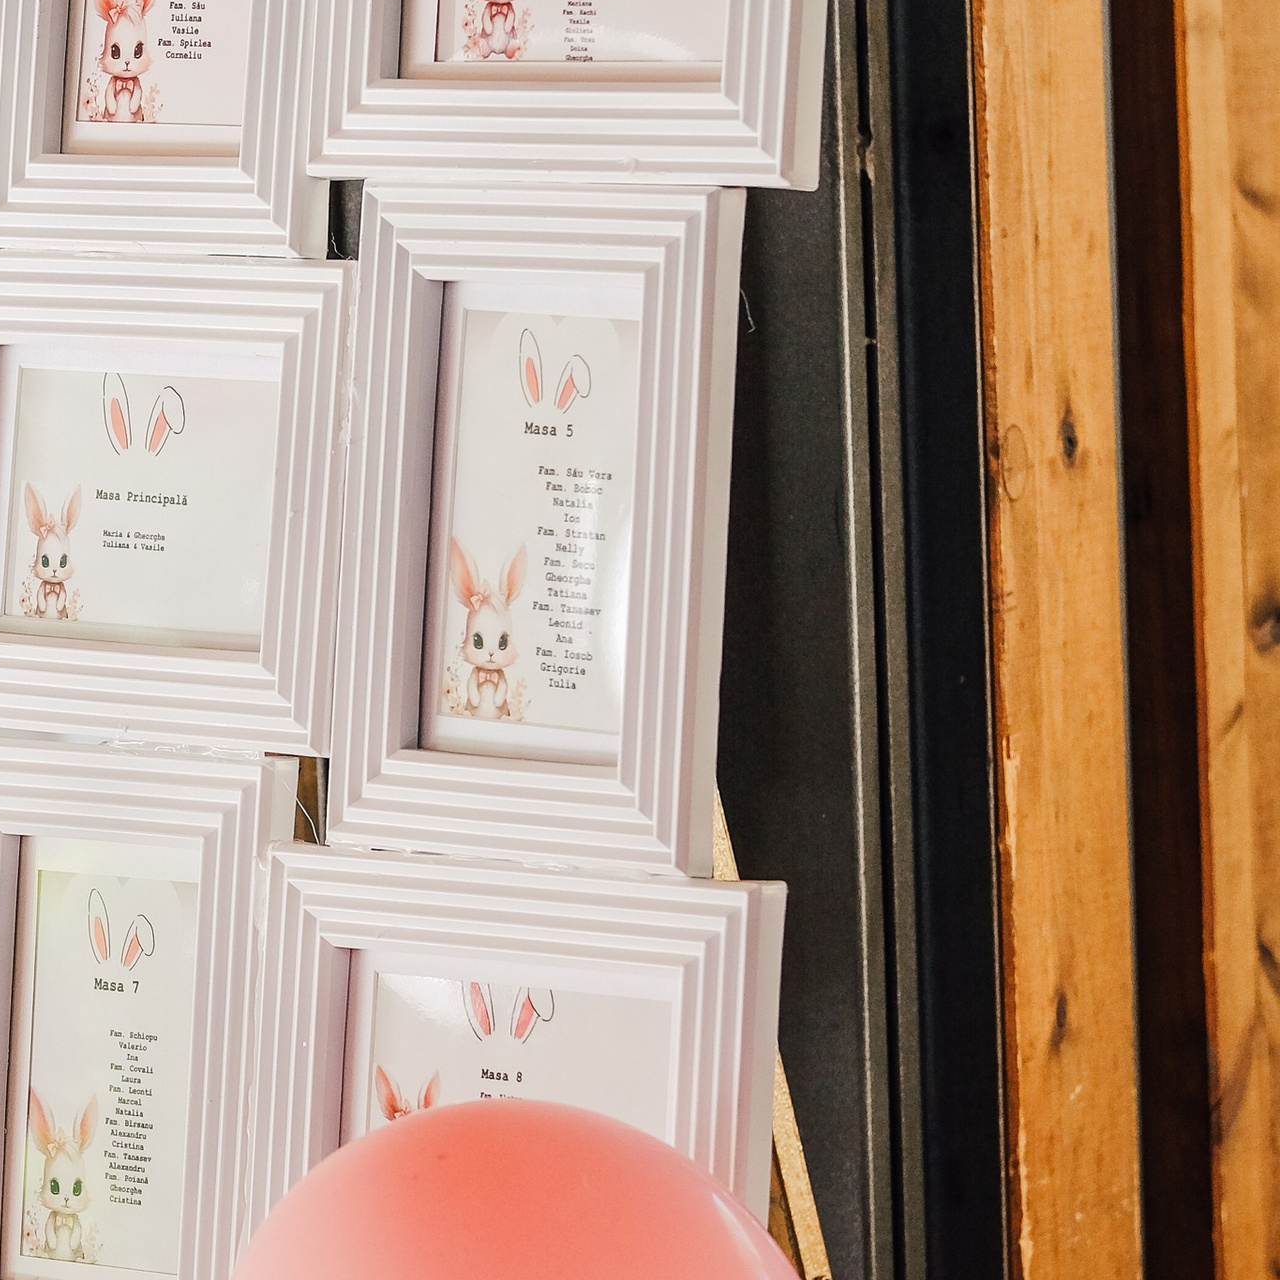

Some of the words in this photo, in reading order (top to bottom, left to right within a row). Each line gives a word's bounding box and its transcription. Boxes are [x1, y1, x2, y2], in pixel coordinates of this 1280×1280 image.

[169, 1, 187, 10] Fam.
[170, 13, 203, 23] Iuliana
[171, 25, 200, 35] Vasile
[157, 38, 175, 47] Fam.
[165, 50, 202, 60] Corneliu
[523, 421, 557, 437] Masa
[565, 423, 574, 438] 5
[538, 465, 561, 477] Fam.
[545, 481, 568, 492] Fam.
[95, 489, 121, 501] Masa
[126, 491, 188, 506] Principală
[537, 525, 560, 537] Fam.
[543, 556, 566, 568] Fam.
[532, 600, 555, 612] Fam.
[535, 646, 558, 658] Fam.
[93, 977, 125, 993] Masa
[132, 980, 140, 994] 7
[109, 1029, 126, 1039] Fam.
[109, 1062, 126, 1072] Fam.
[480, 1068, 509, 1082] Masa
[515, 1071, 523, 1083] 8
[108, 1084, 125, 1094] Fam.
[105, 1117, 121, 1126] Fam.
[103, 1150, 120, 1160] Fam.
[104, 1172, 121, 1181] Fam.
